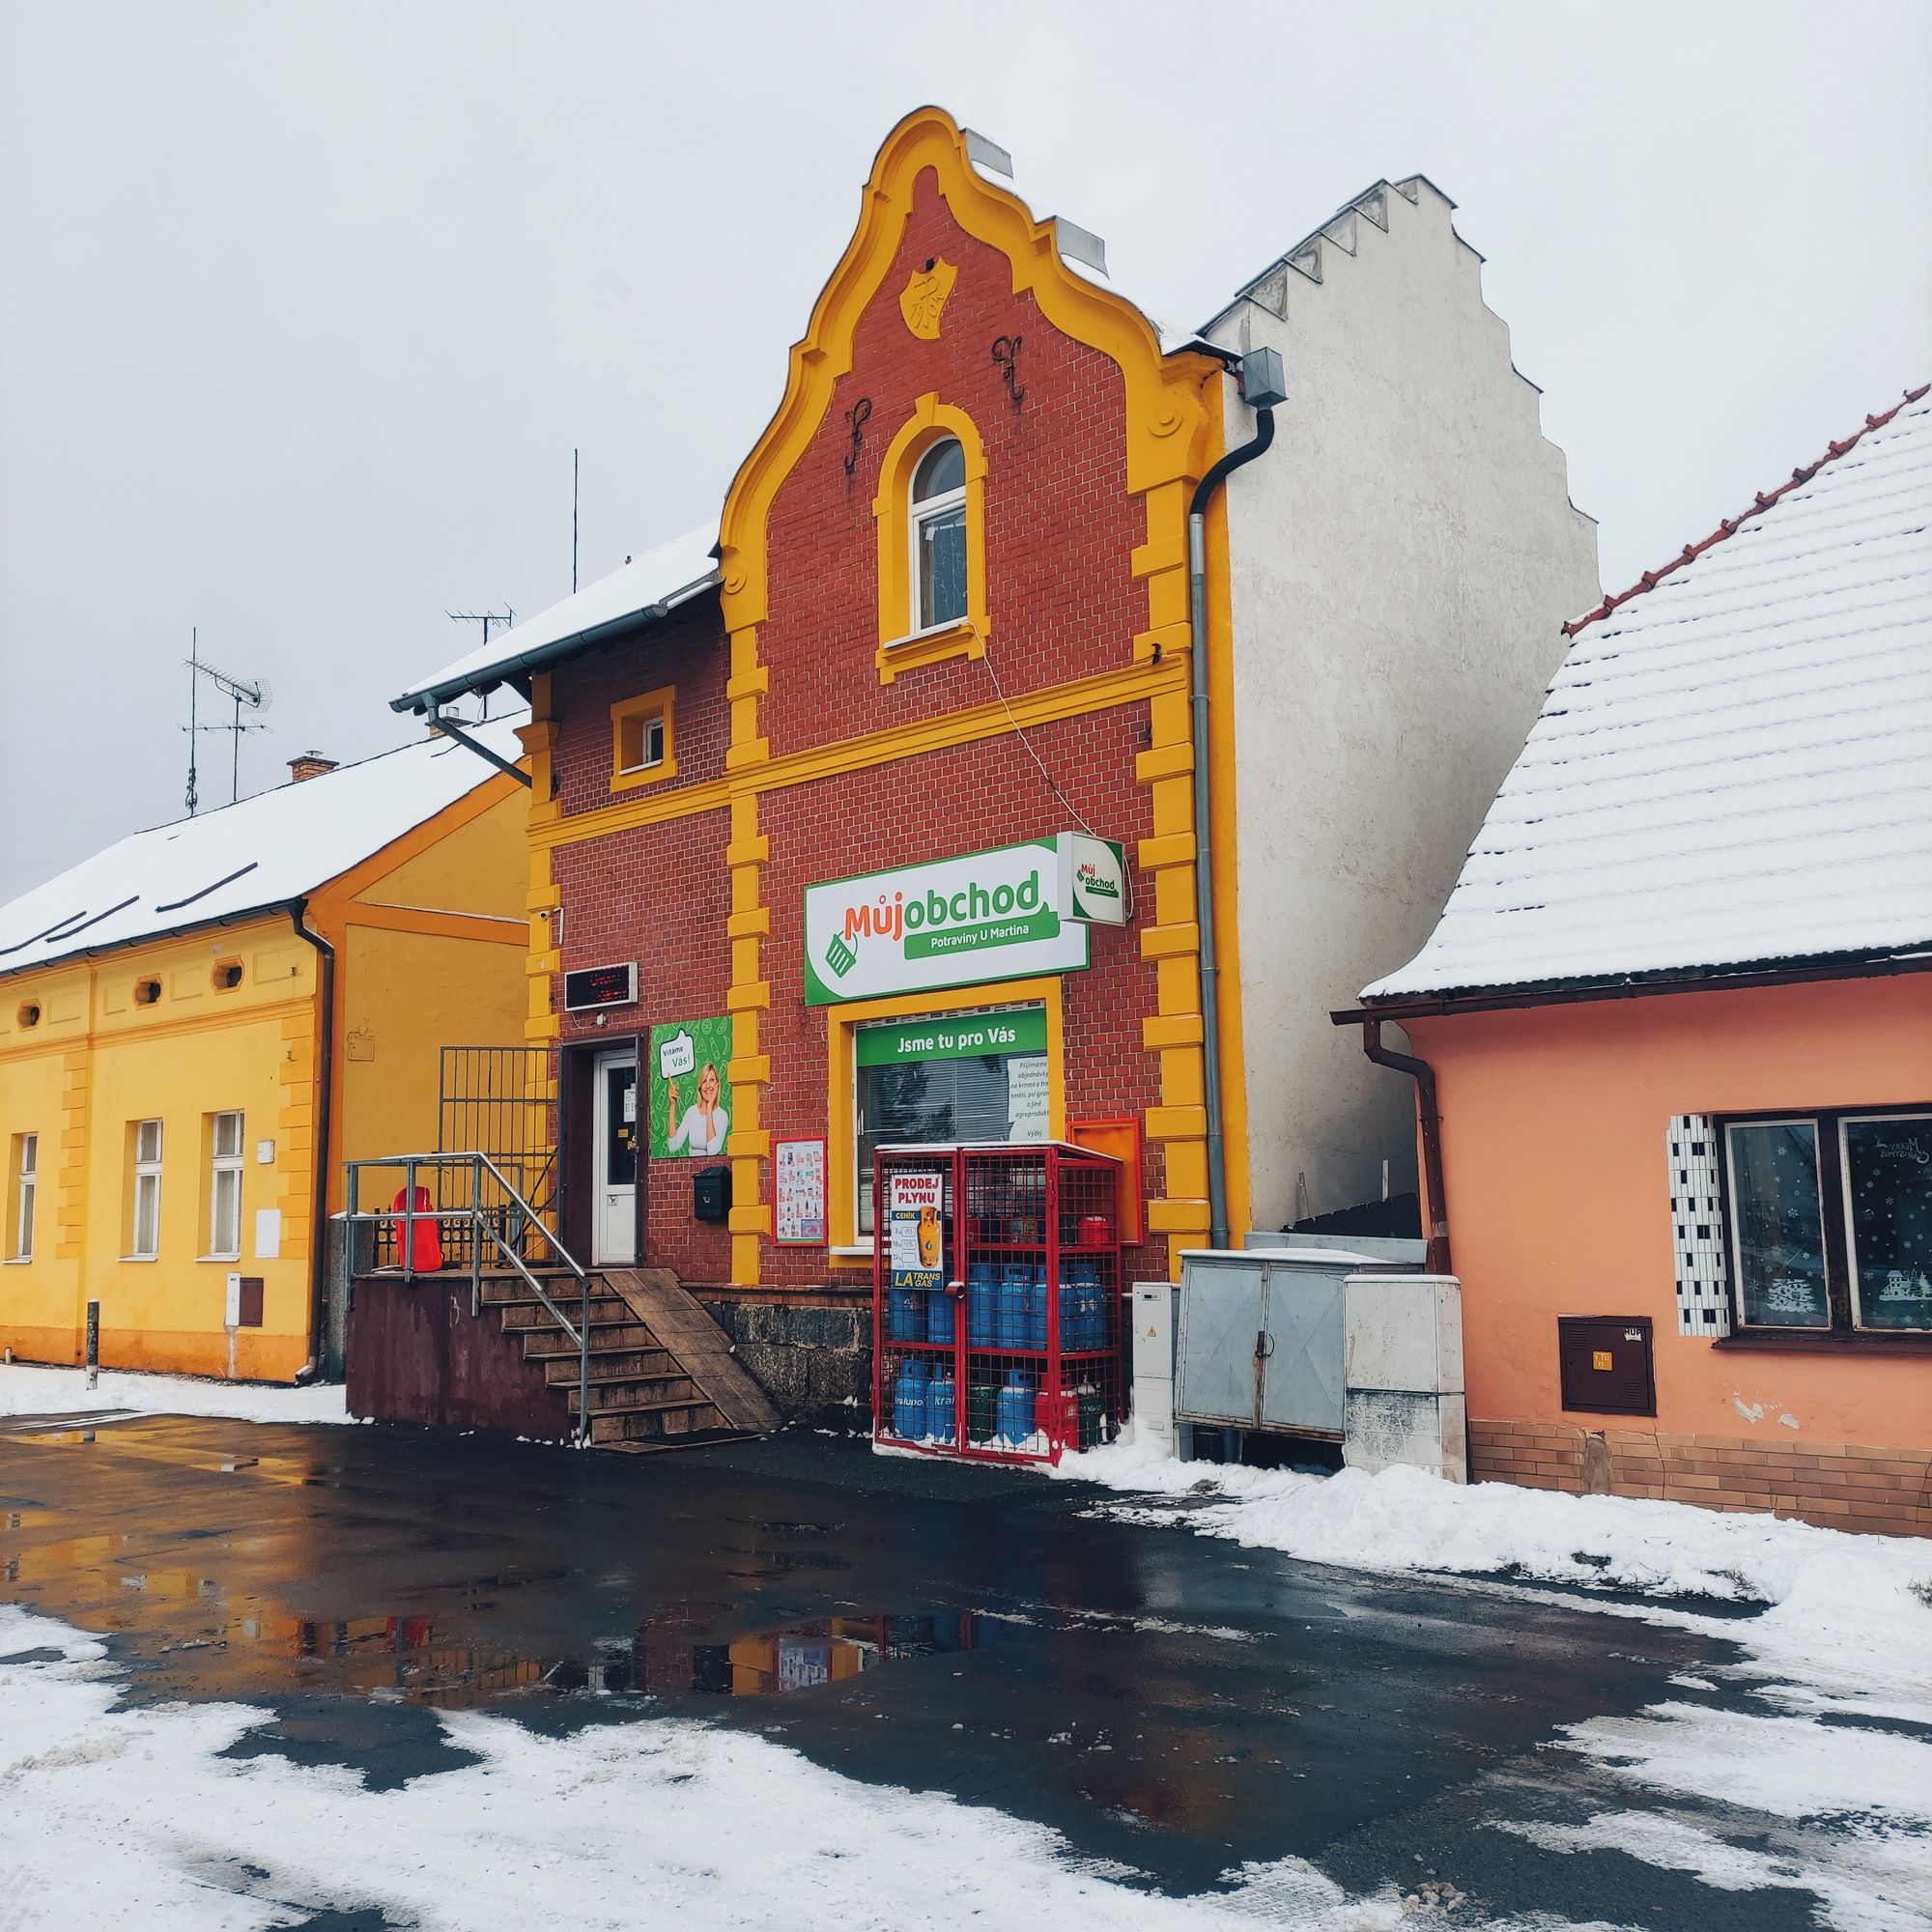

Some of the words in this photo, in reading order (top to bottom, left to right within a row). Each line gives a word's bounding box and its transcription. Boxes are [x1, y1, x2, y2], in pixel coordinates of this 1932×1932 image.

[1085, 875, 1115, 890] obchod
[930, 928, 979, 950] Potraviny
[980, 929, 988, 941] U
[989, 923, 1030, 940] Martina
[896, 1037, 934, 1054] Jsme
[937, 1034, 954, 1049] tu
[957, 1032, 984, 1051] pro
[986, 1026, 1016, 1044] Vás
[671, 1054, 691, 1067] Vás!
[895, 1178, 940, 1190] PRODEJ
[897, 1192, 935, 1204] PLYNU
[895, 1210, 916, 1220] CENÍK
[895, 1271, 913, 1287] LA
[913, 1271, 941, 1281] TRANS
[915, 1279, 933, 1288] GAS
